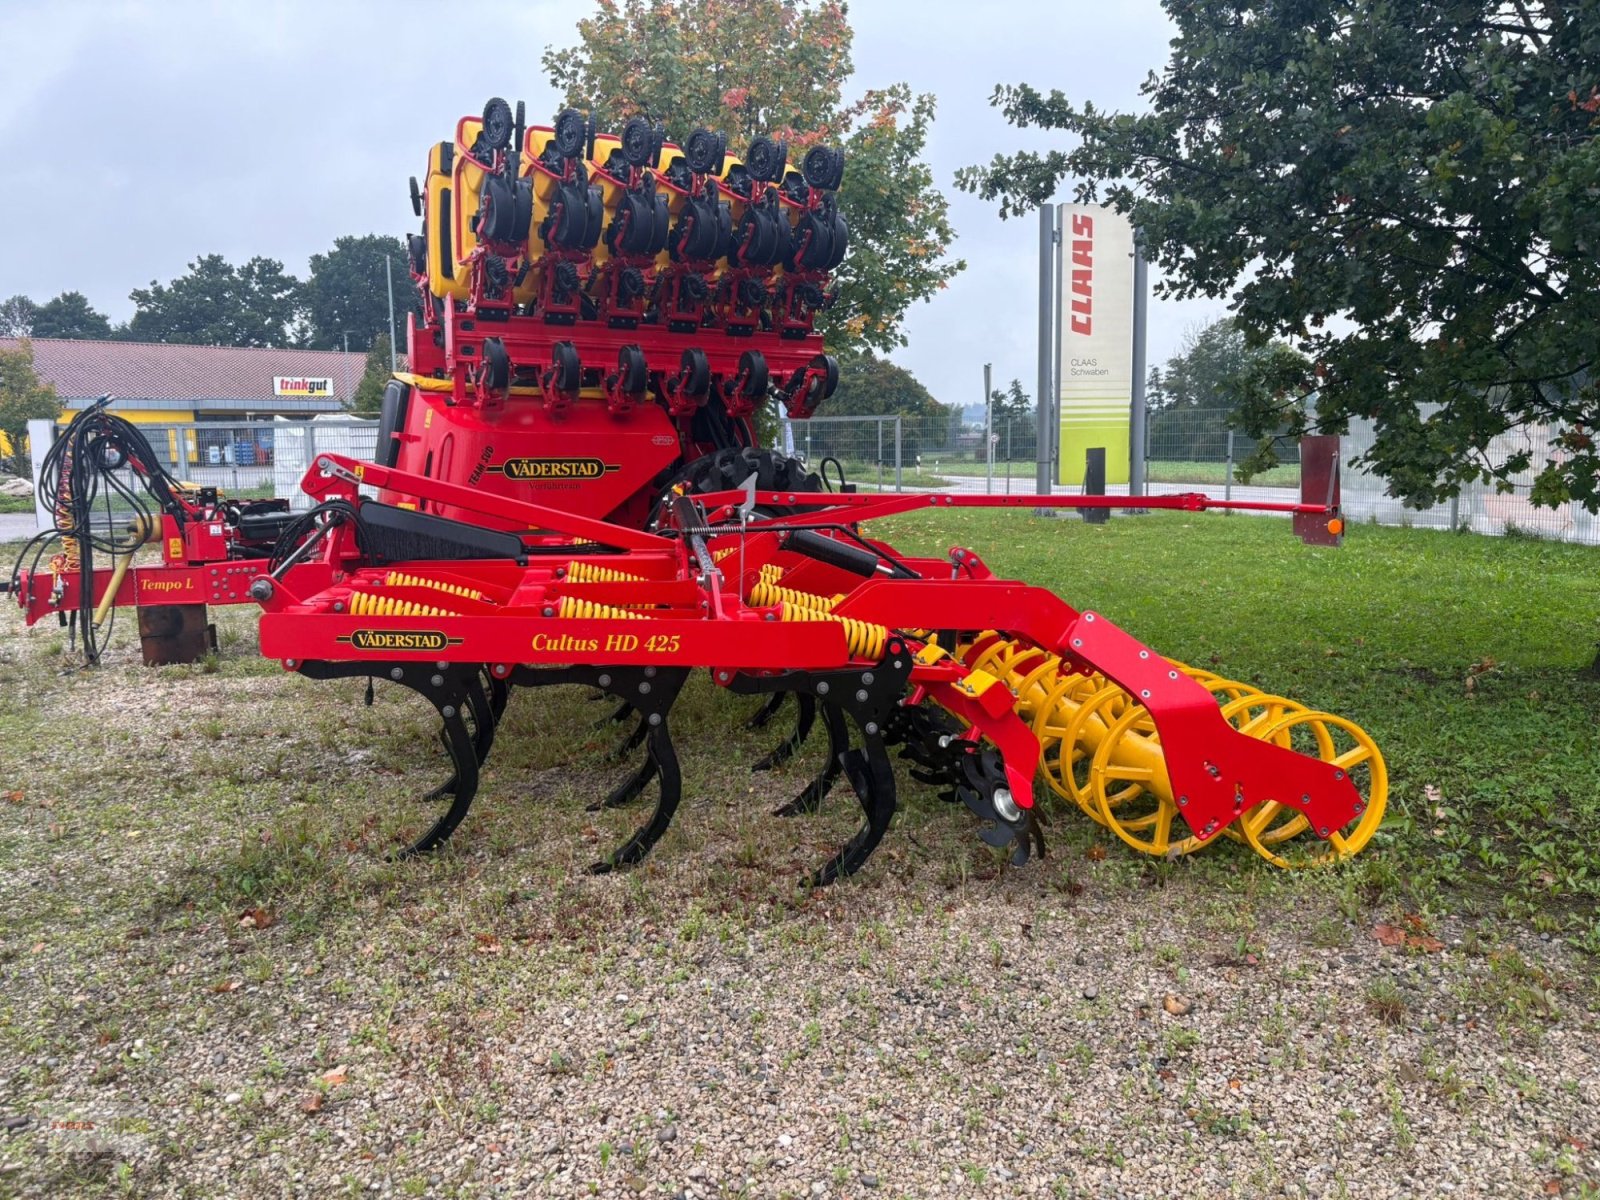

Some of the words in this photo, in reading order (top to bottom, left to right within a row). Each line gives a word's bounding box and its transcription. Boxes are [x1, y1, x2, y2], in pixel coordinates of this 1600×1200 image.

[1071, 213, 1093, 336] CLAAS
[1070, 358, 1097, 367] CLAAS
[1070, 367, 1109, 376] Schwaben
[280, 378, 328, 394] trinkgut
[468, 463, 486, 486] TEAM
[510, 459, 599, 477] VÄDERSTAD
[140, 578, 182, 592] Tempo
[185, 577, 194, 589] L
[357, 630, 441, 648] VÄDERSTAD
[531, 633, 599, 652] Cultus
[604, 634, 639, 652] HD
[643, 634, 681, 653] 425
